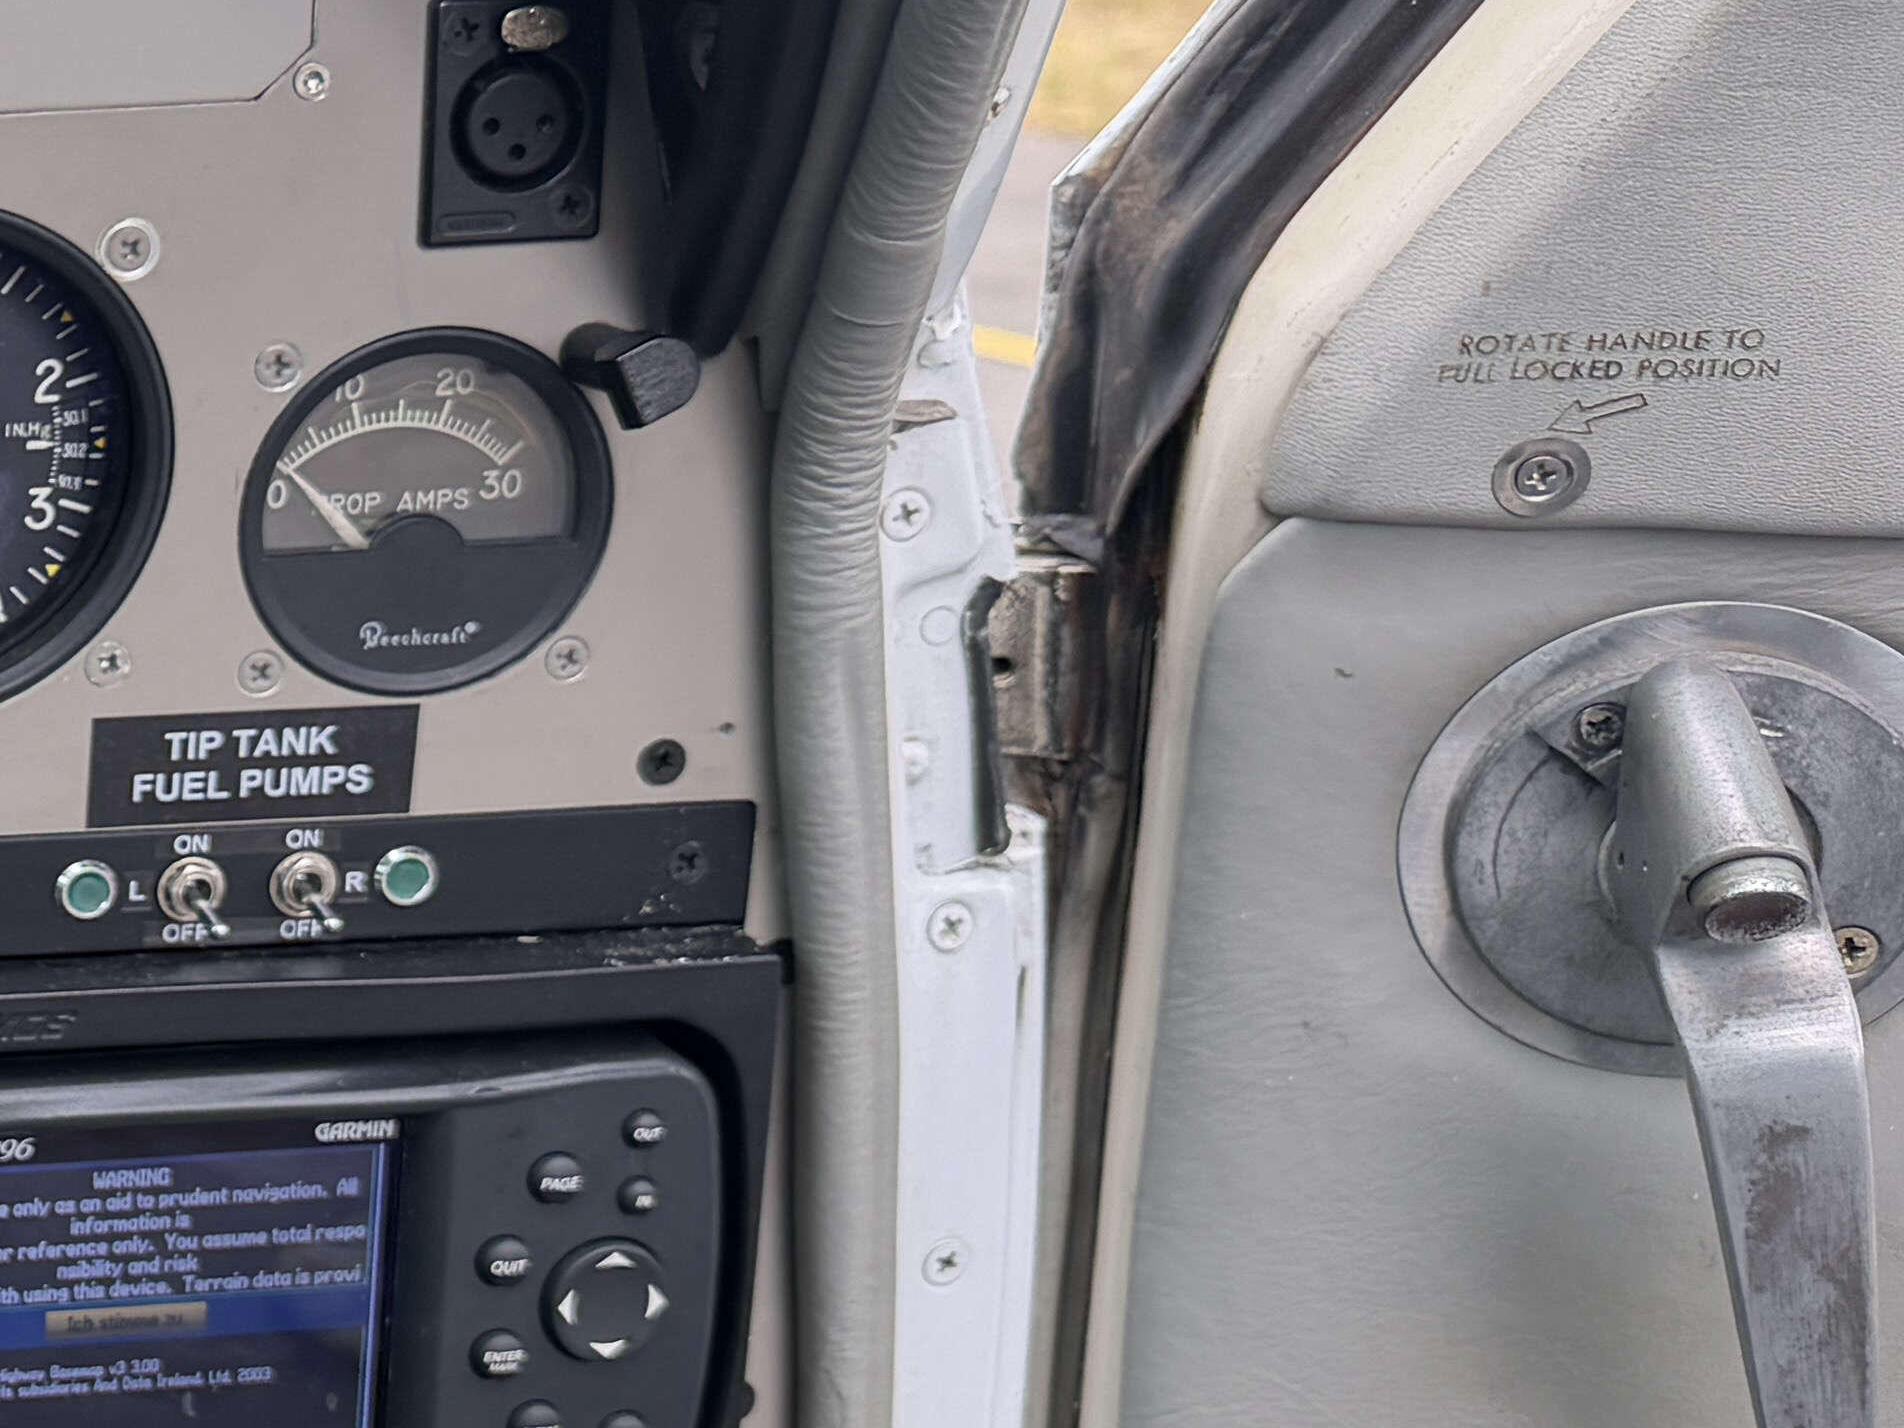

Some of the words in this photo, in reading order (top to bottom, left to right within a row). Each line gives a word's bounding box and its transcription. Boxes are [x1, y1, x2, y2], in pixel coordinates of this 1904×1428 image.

[1458, 332, 1579, 357] ROTATE
[1586, 330, 1710, 352] HANDLE
[1723, 328, 1765, 350] TO
[1510, 358, 1623, 380] LOCKED
[1637, 358, 1781, 380] POSITION
[165, 730, 225, 761] TIP
[232, 725, 340, 758] TANK
[132, 772, 230, 803] FUEL
[239, 764, 374, 799] PUMPS
[314, 1120, 395, 1142] GARMIN
[93, 1167, 171, 1189] WARNING
